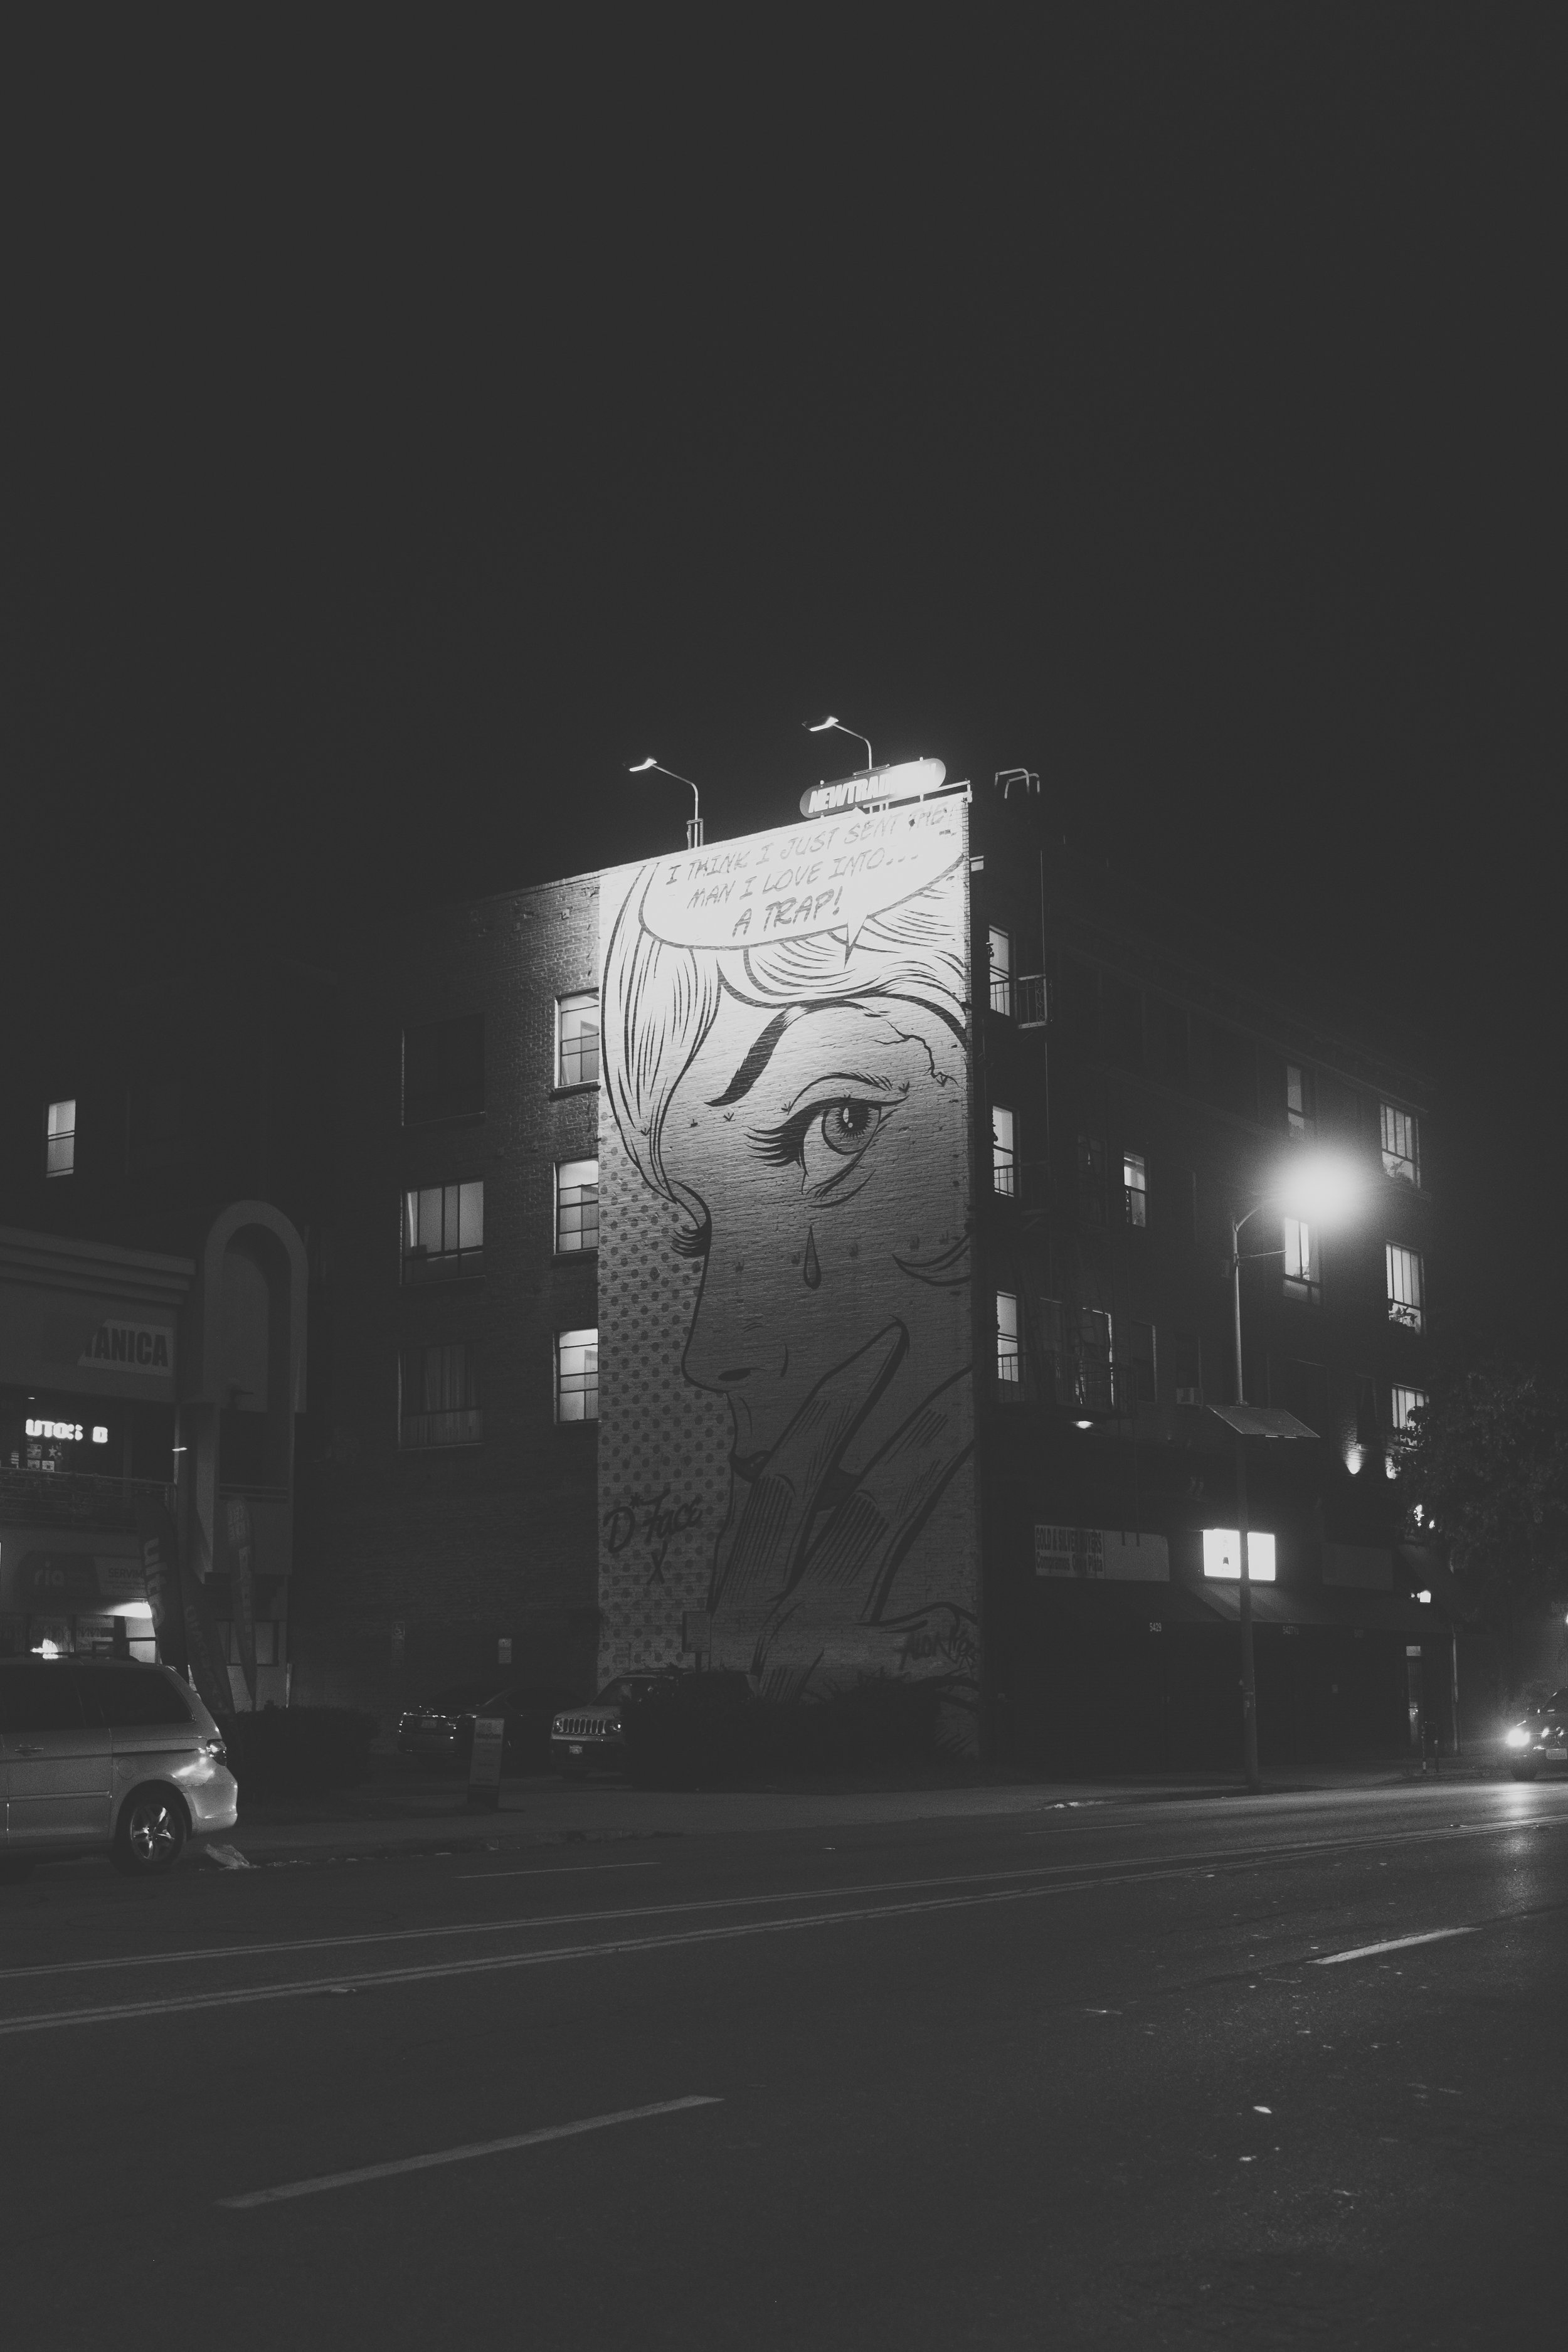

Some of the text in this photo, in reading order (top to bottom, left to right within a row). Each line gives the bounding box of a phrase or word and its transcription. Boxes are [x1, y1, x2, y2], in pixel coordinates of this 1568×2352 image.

[666, 864, 682, 886] I
[688, 850, 752, 881] THINK
[755, 842, 775, 866] I
[780, 827, 841, 859] JUST
[844, 813, 904, 844] SENT
[686, 847, 919, 911] MAN I LOVE INTO...
[731, 885, 844, 938] A TRAP!
[1036, 1527, 1052, 1550] GOLD
